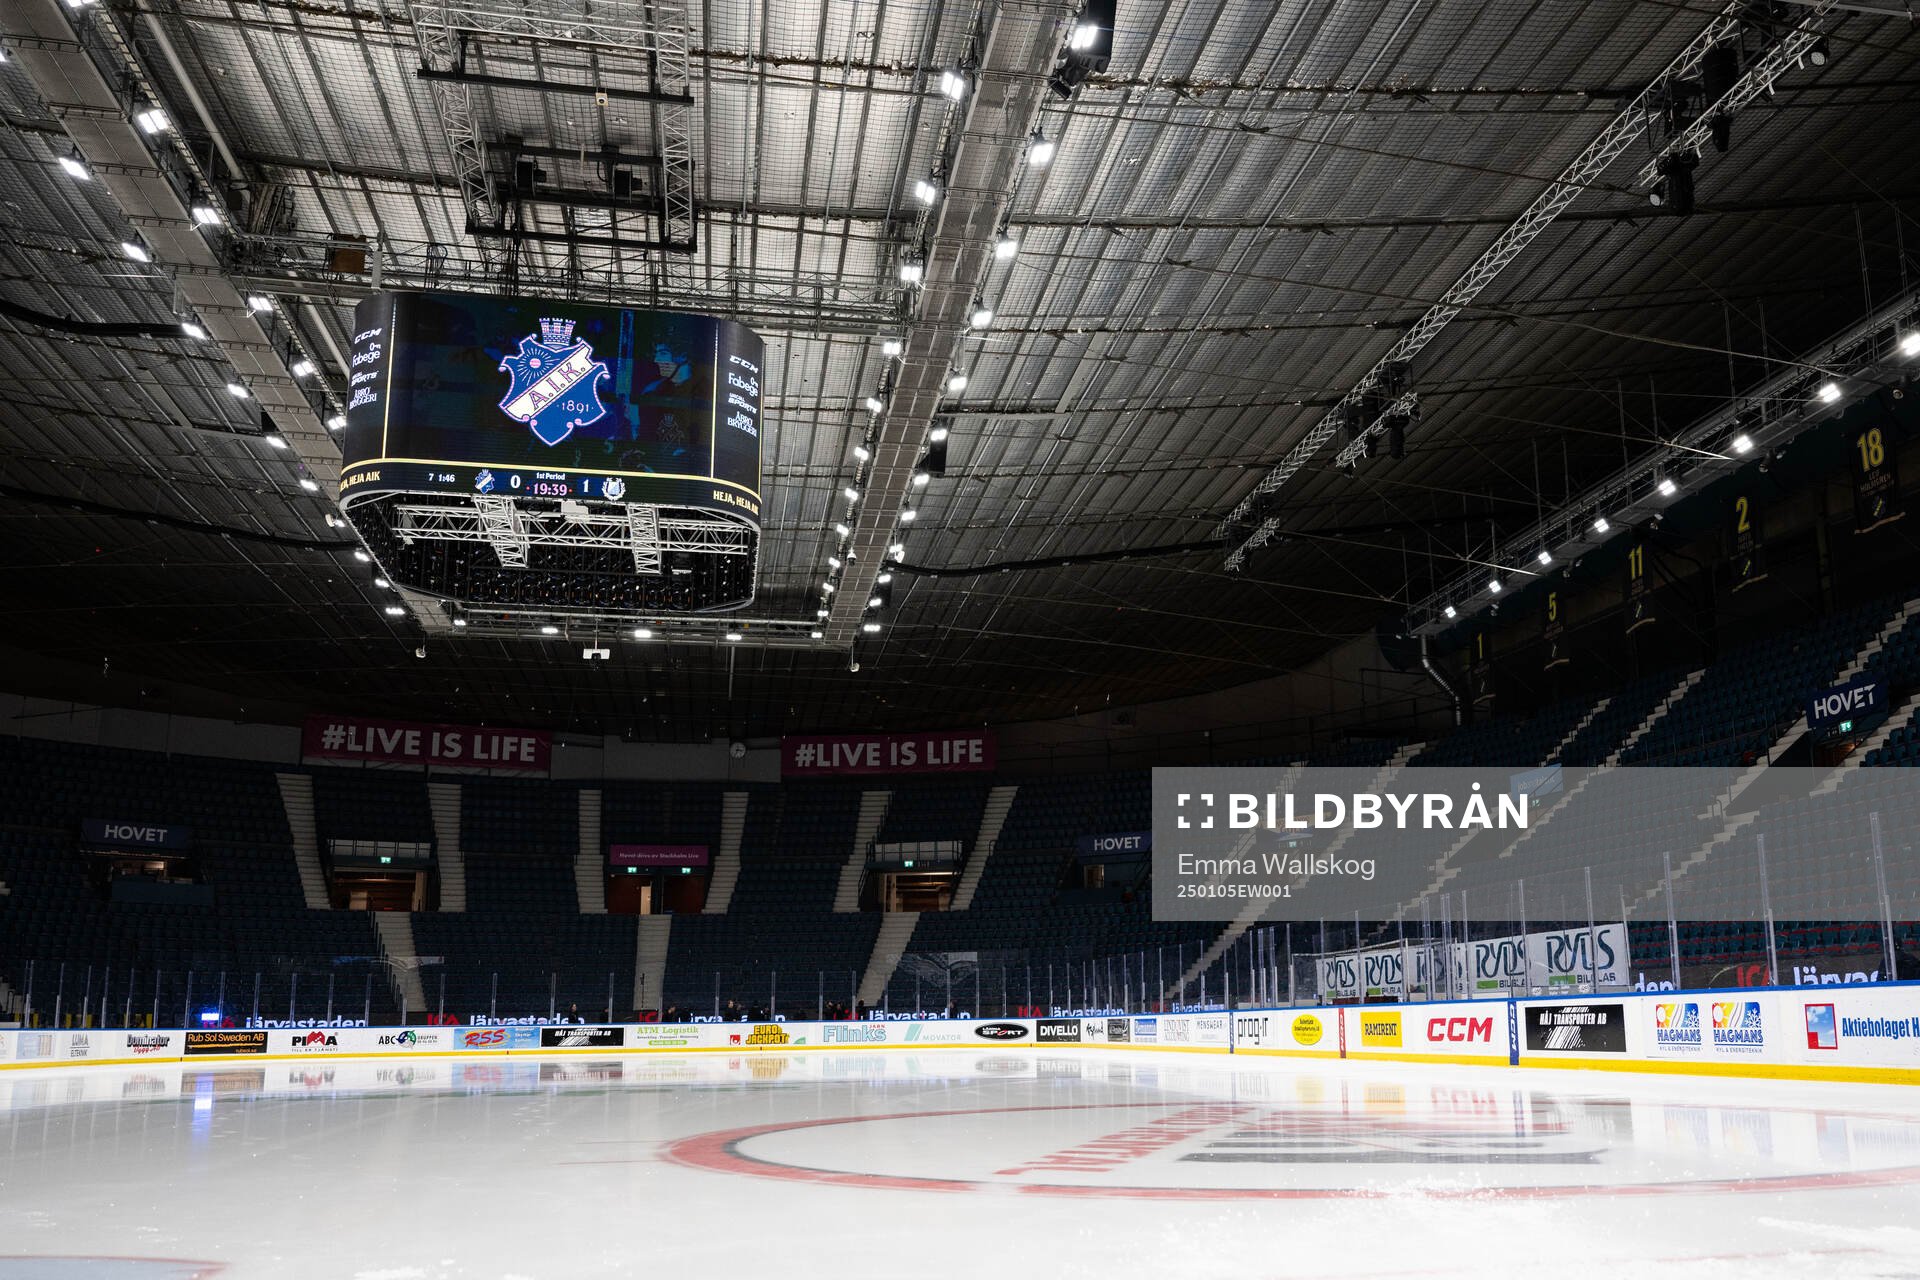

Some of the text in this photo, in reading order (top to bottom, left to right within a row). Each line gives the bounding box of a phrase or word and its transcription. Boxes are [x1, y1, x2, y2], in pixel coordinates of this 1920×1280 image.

[354, 328, 382, 344] CCM
[352, 350, 380, 367] Fabege
[729, 355, 759, 374] CCM
[728, 372, 758, 397] Fabege
[1857, 427, 1885, 472] 18
[349, 474, 365, 486] HEJA
[366, 471, 381, 482] AIK
[510, 475, 521, 489] 0
[536, 472, 566, 481] 1st Period
[533, 483, 567, 495] 19:39
[583, 479, 589, 492] 1
[713, 490, 736, 506] HEJA,
[1735, 496, 1751, 534] 2
[1628, 544, 1644, 580] 11
[1548, 592, 1558, 622] 5
[1814, 683, 1876, 719] HOVET
[321, 724, 536, 762] #LIVE IS LIFE
[795, 739, 983, 767] #LIVE IS LIFE
[104, 824, 168, 843] HOVET
[1094, 836, 1141, 852] HOVET
[1539, 1010, 1607, 1025] HÅJ TRANSPORTER AB
[662, 1025, 699, 1035] Logistik
[753, 1025, 778, 1035] EURO
[823, 1025, 887, 1042] Flinks
[1364, 1023, 1398, 1036] RAMIRENT
[1426, 1017, 1493, 1042] CCM
[1656, 1029, 1702, 1042] HAGMANS
[1713, 1029, 1764, 1043] HAGMANS
[1842, 1017, 1911, 1039] Aktiebolaget
[127, 1034, 170, 1047] Dominator
[187, 1034, 265, 1042] Rub Sol Sweden AB
[378, 1035, 396, 1045] ABC
[465, 1029, 505, 1047] RSS
[745, 1033, 790, 1045] JACKPOT
